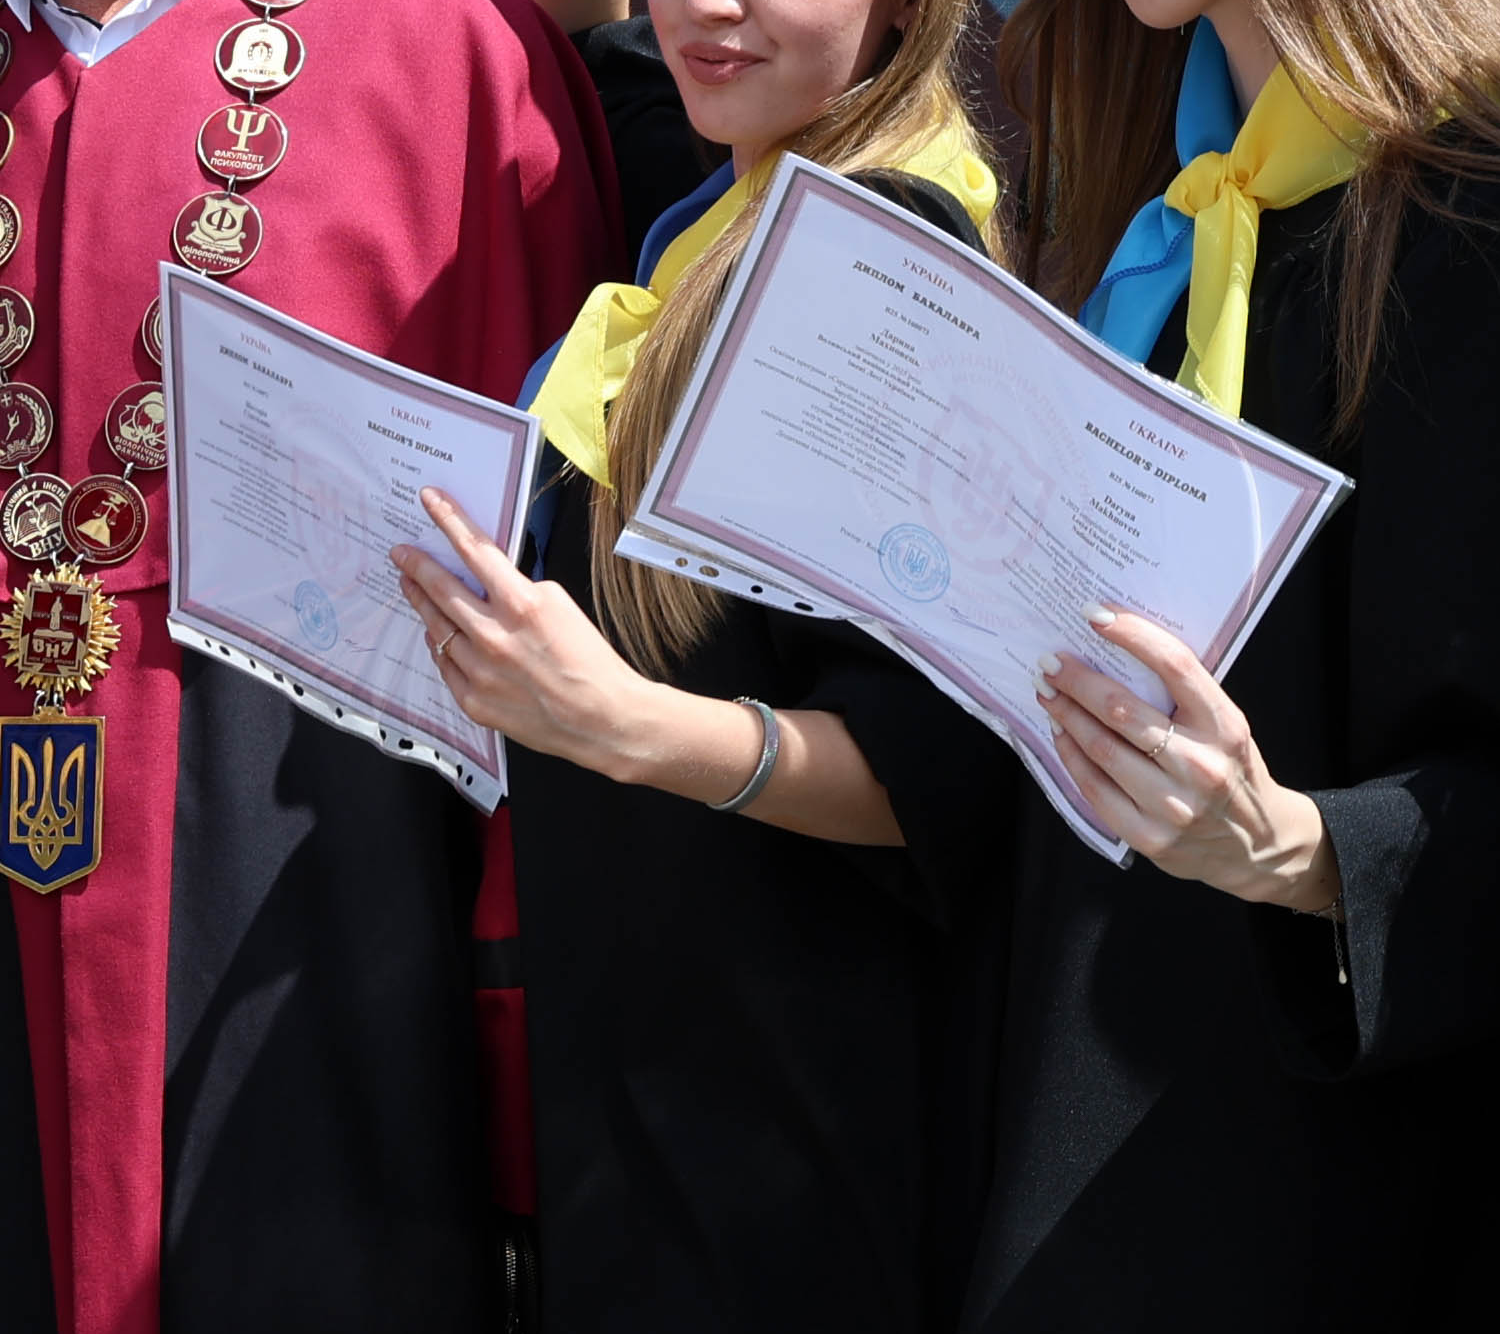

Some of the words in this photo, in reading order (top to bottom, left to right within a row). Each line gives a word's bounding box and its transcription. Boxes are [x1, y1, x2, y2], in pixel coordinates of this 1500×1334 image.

[213, 149, 265, 163] ФАКУЛЬТЕТ
[181, 244, 241, 266] філологічний
[902, 258, 953, 295] УКРАЇНА
[853, 261, 905, 293] ДИПЛОМ
[912, 292, 979, 339] БАКАЛАВРА
[871, 333, 920, 367] Махновець
[878, 329, 915, 352] Дарина
[391, 406, 430, 430] UKRAINE
[113, 435, 166, 462] БІОЛОГІЧНИЙ
[368, 420, 413, 447] BACHELOR'S
[415, 442, 452, 462] DIPLOMA
[1129, 420, 1184, 458] UKRAINE
[114, 444, 160, 467] ФАКУЛЬТЕТ
[1085, 422, 1152, 471] BACHELOR'S
[1154, 467, 1206, 502] DIPLOMA
[42, 481, 68, 500] ІНСТИ
[1089, 498, 1140, 537] Makhnovets
[1104, 495, 1135, 522] Daryna
